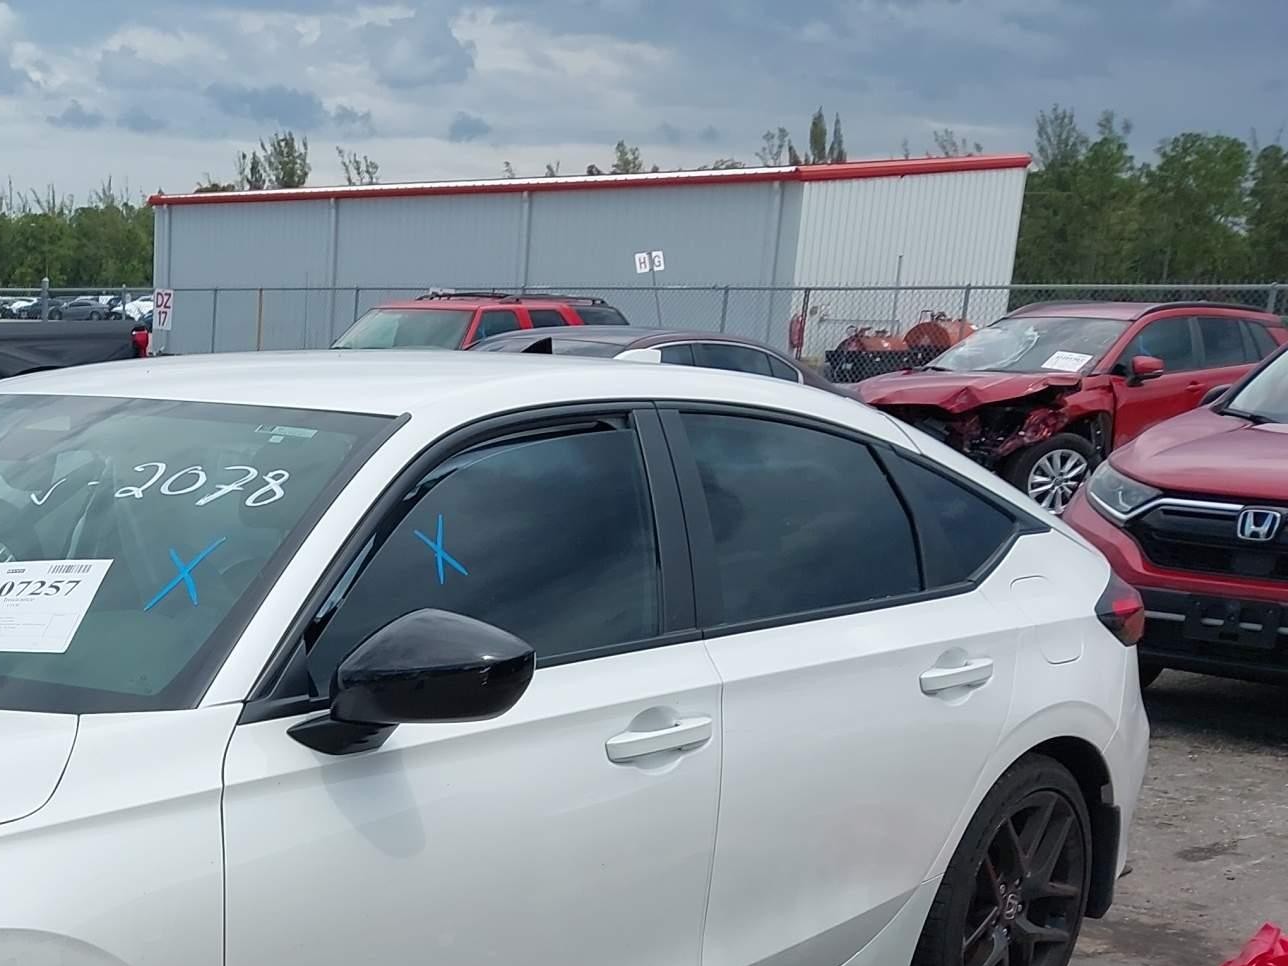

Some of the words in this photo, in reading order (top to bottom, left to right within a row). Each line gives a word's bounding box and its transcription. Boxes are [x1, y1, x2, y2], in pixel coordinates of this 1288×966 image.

[156, 292, 171, 309] DZ
[158, 310, 168, 327] 17
[114, 462, 290, 507] 2078
